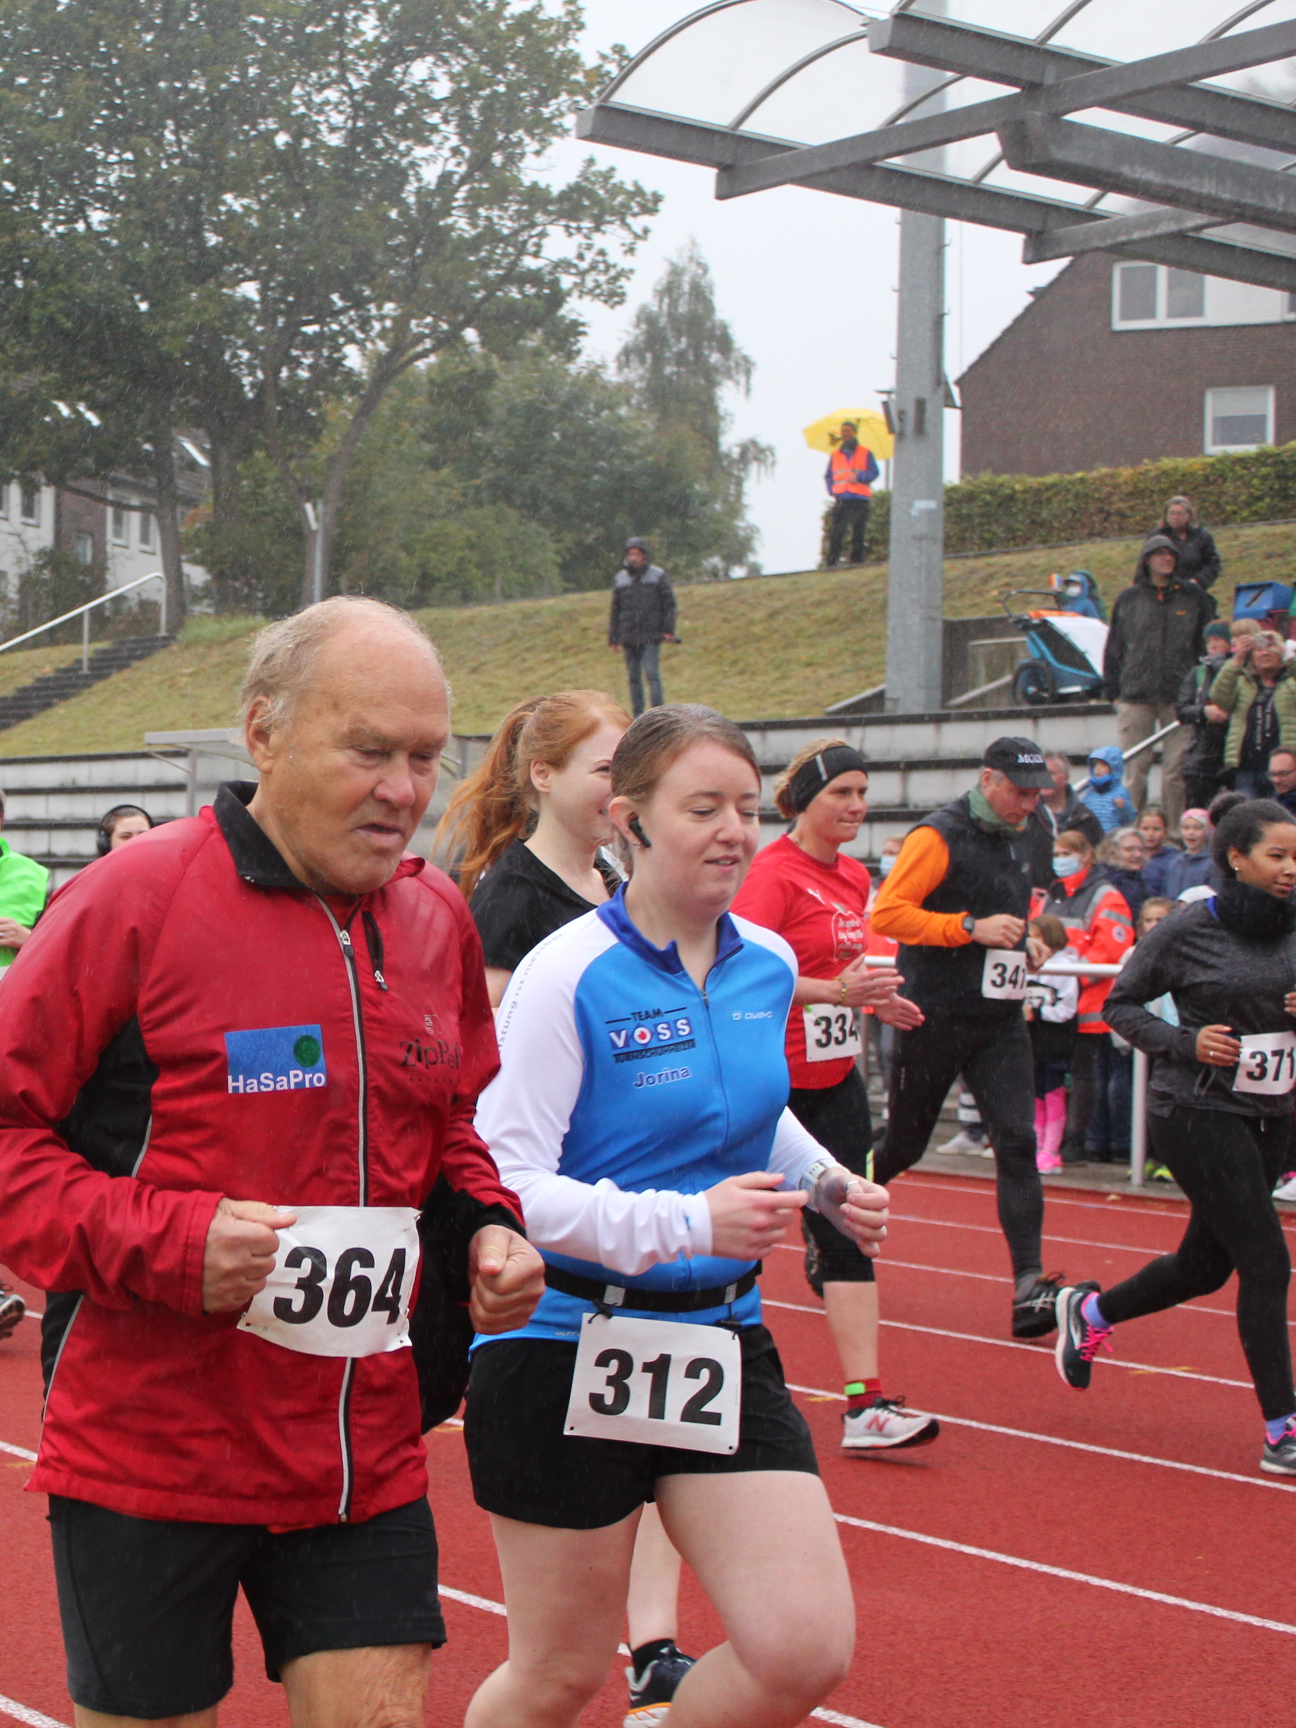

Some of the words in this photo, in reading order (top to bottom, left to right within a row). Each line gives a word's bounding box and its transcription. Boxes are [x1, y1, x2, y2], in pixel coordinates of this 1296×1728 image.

[498, 1000, 518, 1050] istung
[630, 1008, 664, 1021] TEAM
[608, 1018, 692, 1049] VOSS
[632, 1065, 692, 1089] Jorina
[1245, 1046, 1296, 1082] 371
[227, 1069, 326, 1094] HaSaPro
[273, 1246, 407, 1328] 364
[588, 1348, 725, 1426] 312
